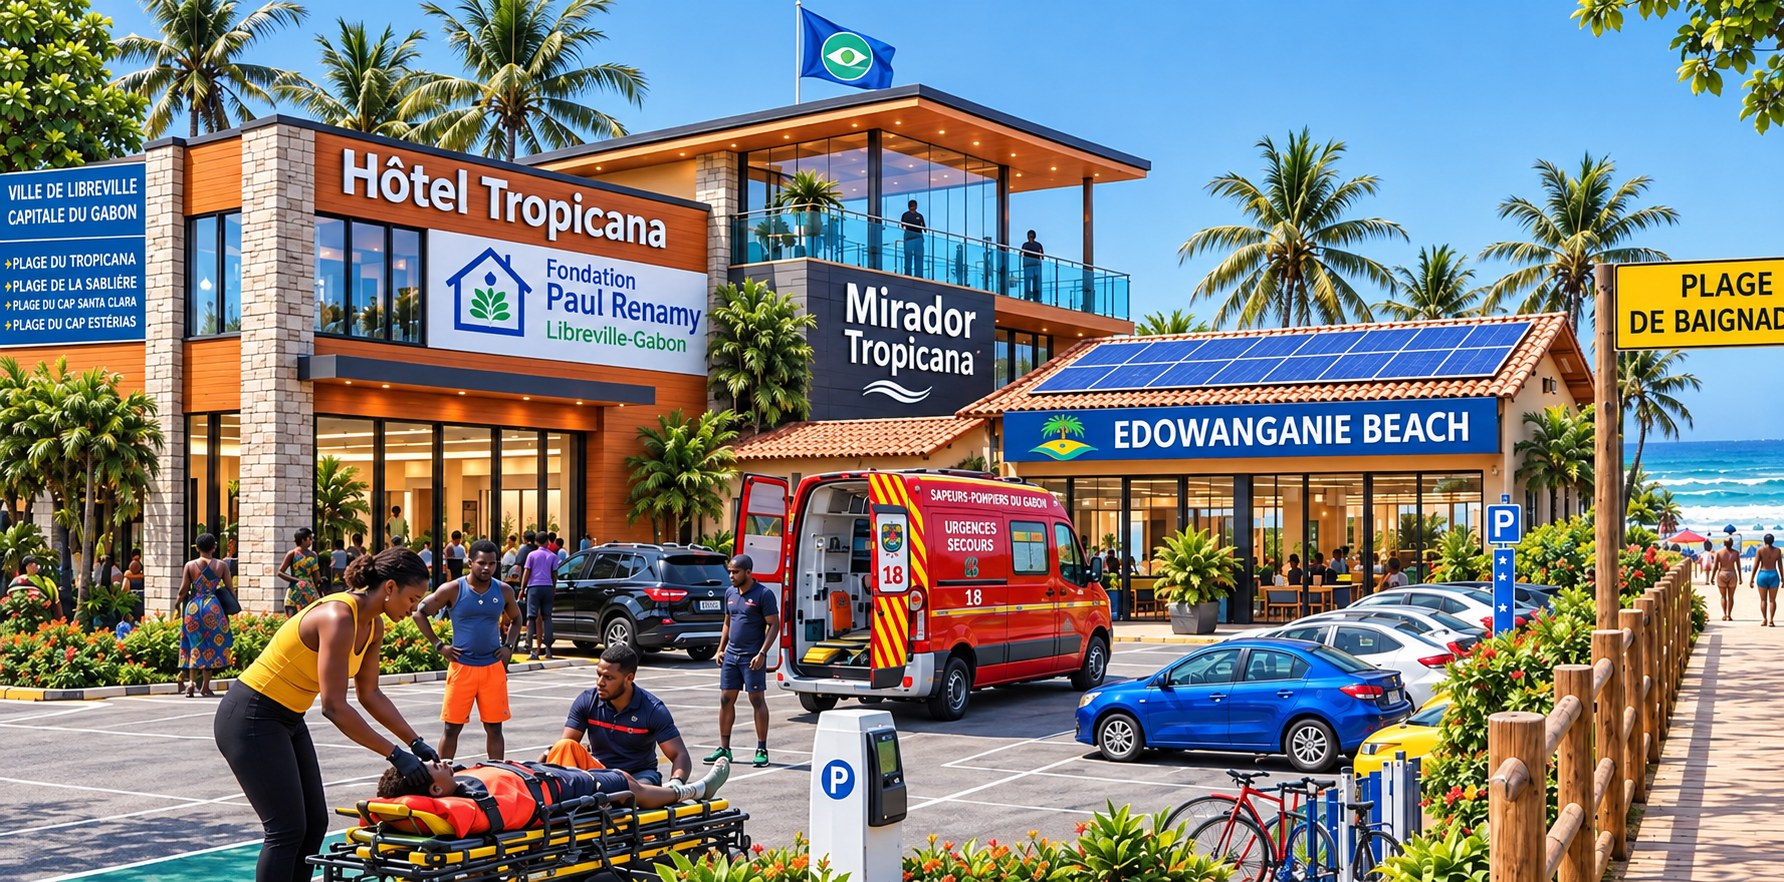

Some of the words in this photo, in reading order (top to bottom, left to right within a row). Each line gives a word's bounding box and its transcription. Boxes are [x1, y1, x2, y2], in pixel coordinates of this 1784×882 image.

[8, 184, 42, 200] VILLE
[47, 182, 63, 199] DE
[68, 178, 137, 198] LIBREVILLE
[343, 148, 468, 215] Hôtel
[481, 175, 667, 249] Tropicana
[8, 208, 64, 225] CAPITALE
[69, 206, 87, 222] DU
[91, 204, 137, 222] GABON
[12, 256, 48, 270] PLAGE
[50, 255, 66, 268] DU
[70, 252, 136, 268] TROPICANA
[12, 279, 48, 292] PLAGE
[51, 278, 66, 292] DE
[68, 278, 82, 291] LA
[547, 258, 636, 290] Fondation
[1682, 272, 1772, 298] PLAGE
[12, 299, 40, 310] PLAGE
[42, 298, 55, 310] DU
[58, 298, 75, 310] CAP
[78, 297, 106, 309] SANTA
[108, 296, 137, 308] CLARA
[547, 282, 603, 316] Paul
[612, 288, 702, 336] Renamy
[845, 282, 976, 339] Mirador
[12, 318, 45, 331] PLAGE
[49, 318, 62, 330] DU
[65, 316, 85, 330] CAP
[1630, 310, 1664, 334] DE
[546, 320, 687, 353] Libreville-Gabon
[844, 328, 974, 376] Tropicana
[1114, 414, 1352, 450] EDOWANGANIE
[1363, 411, 1470, 444] BEACH
[1010, 496, 1022, 506] DU
[1022, 496, 1048, 508] GABON
[944, 520, 997, 535] URGENCES
[1494, 510, 1514, 538] P
[947, 538, 994, 552] SECOURS
[882, 565, 904, 584] 18
[965, 588, 982, 606] 18
[830, 766, 848, 794] P
